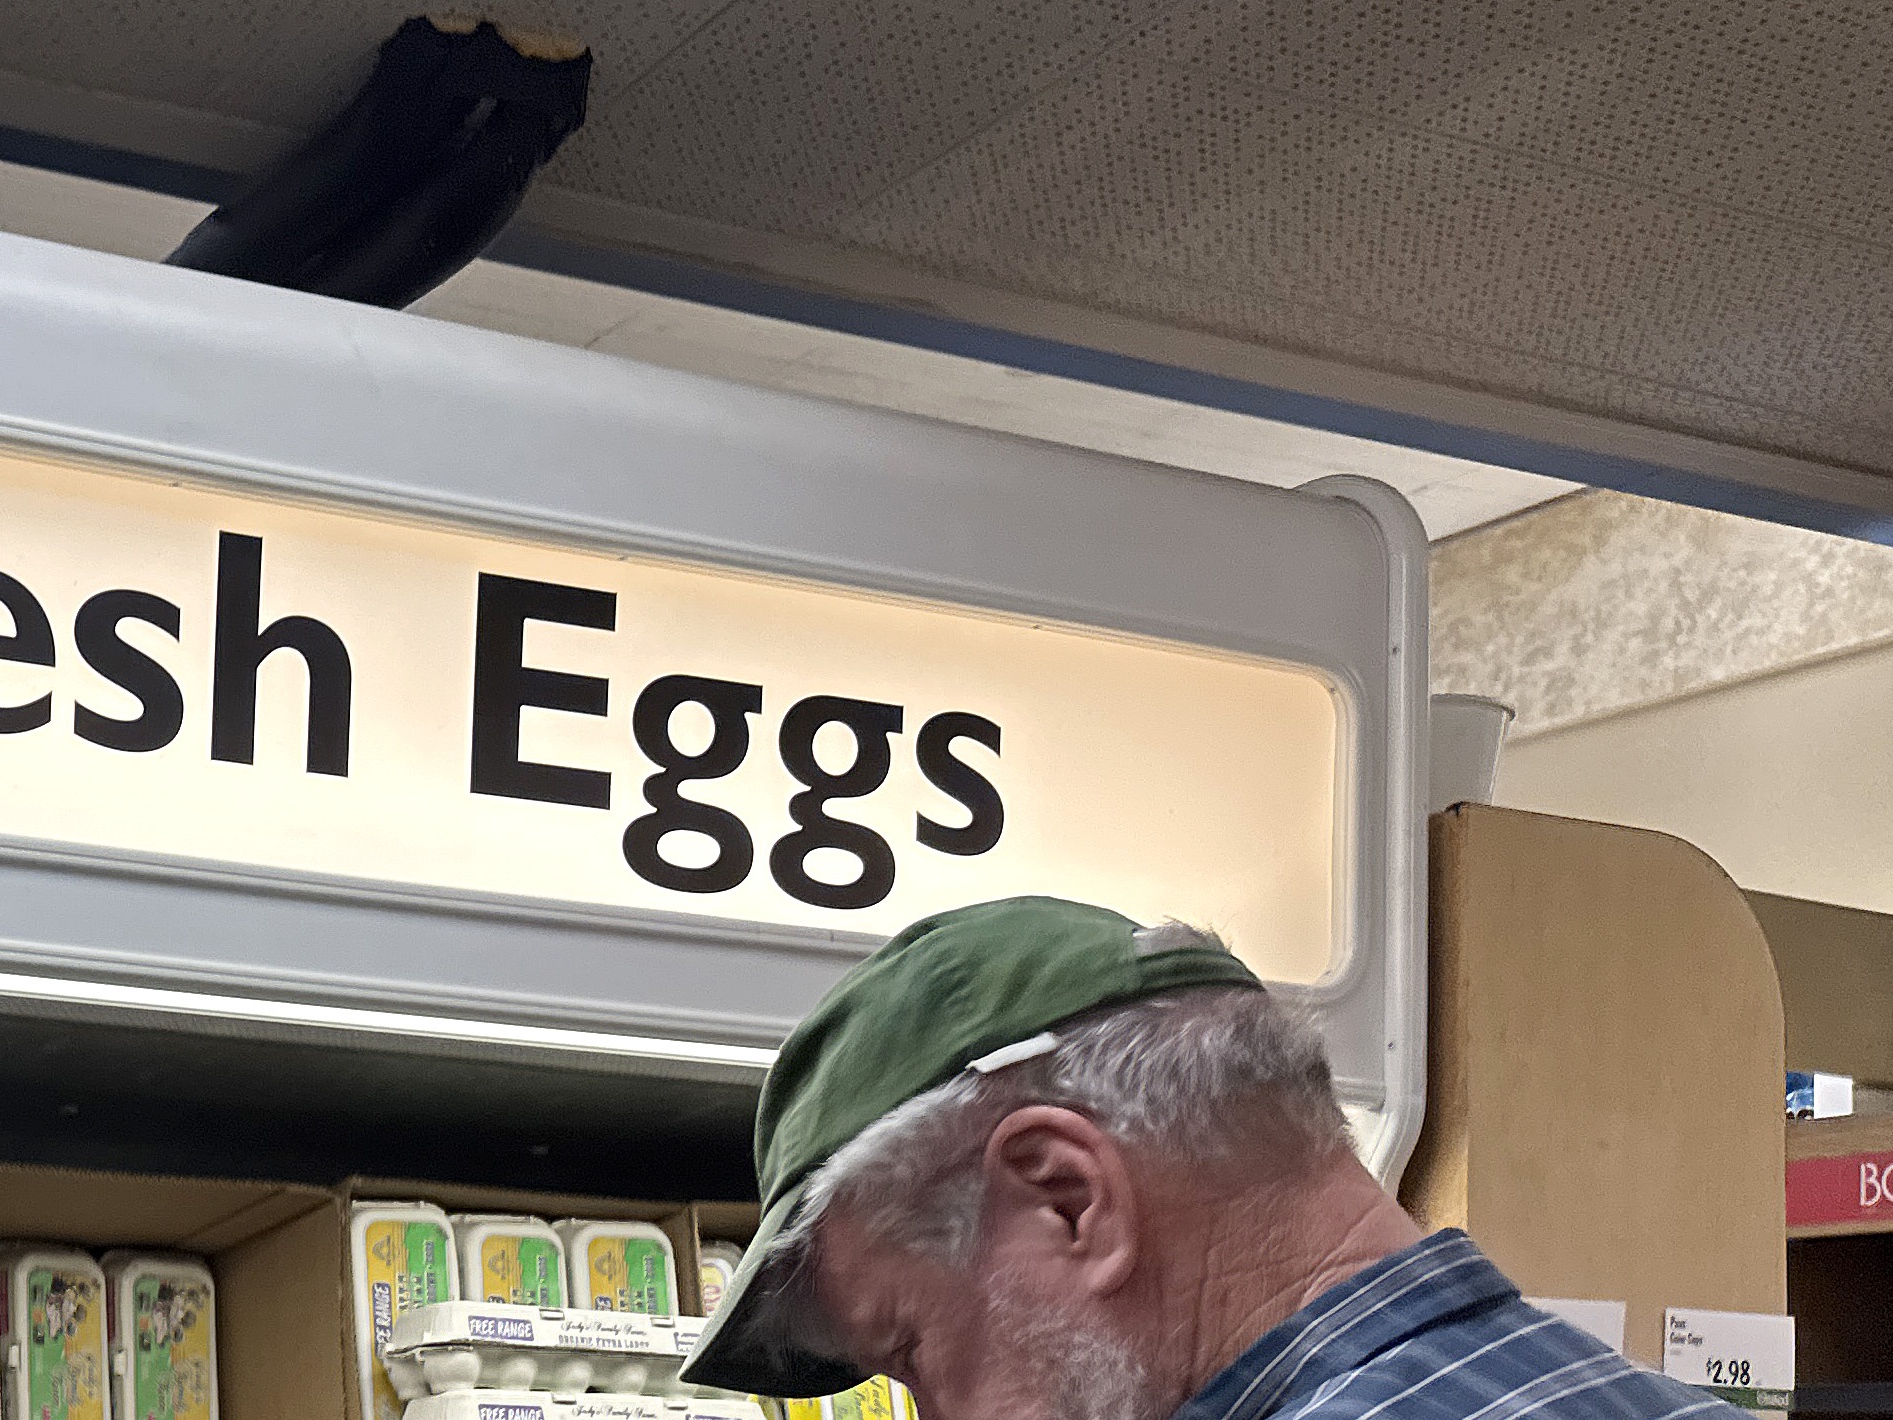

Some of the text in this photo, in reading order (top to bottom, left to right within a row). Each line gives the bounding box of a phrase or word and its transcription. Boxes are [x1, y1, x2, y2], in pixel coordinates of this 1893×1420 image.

[470, 571, 1004, 909] Eggs
[469, 1319, 533, 1339] FREE RANGE
[1707, 1358, 1750, 1385] $2.98
